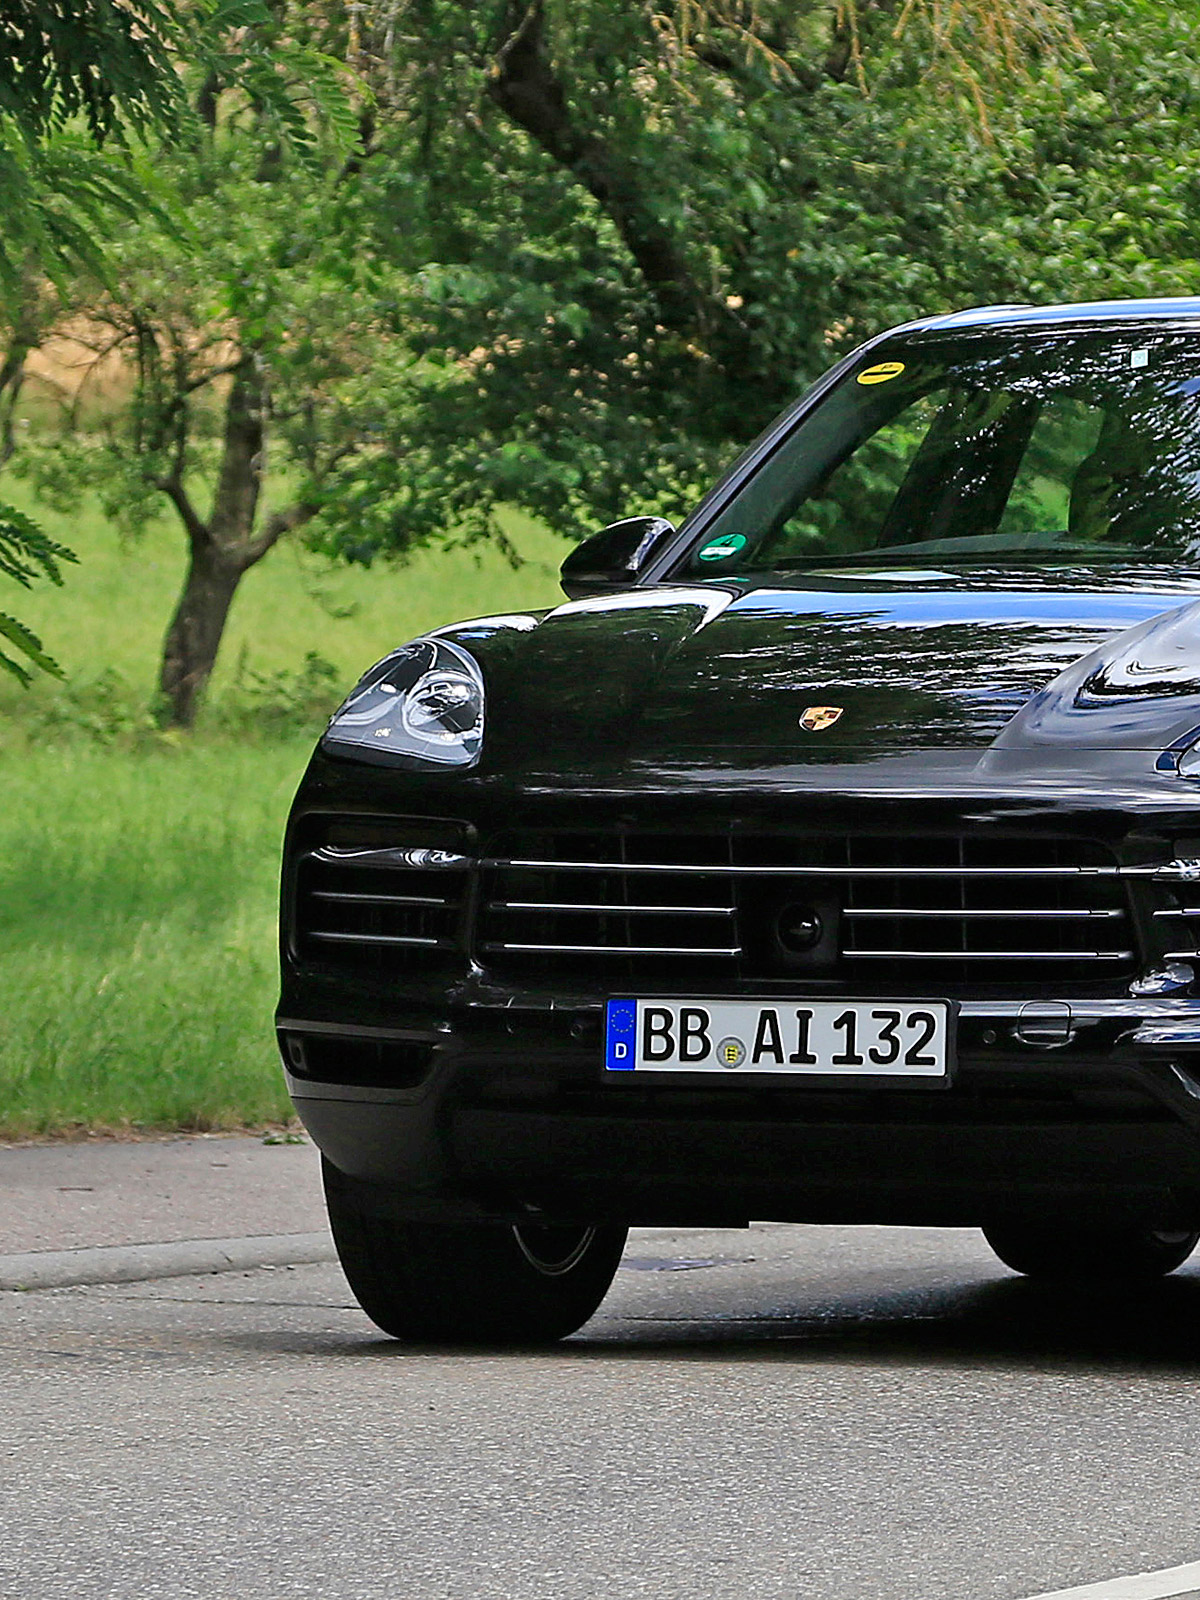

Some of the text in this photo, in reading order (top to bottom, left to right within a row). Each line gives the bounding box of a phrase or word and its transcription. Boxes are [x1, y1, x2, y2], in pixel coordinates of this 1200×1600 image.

[614, 1043, 628, 1059] D
[642, 1007, 937, 1066] BB AI 132
